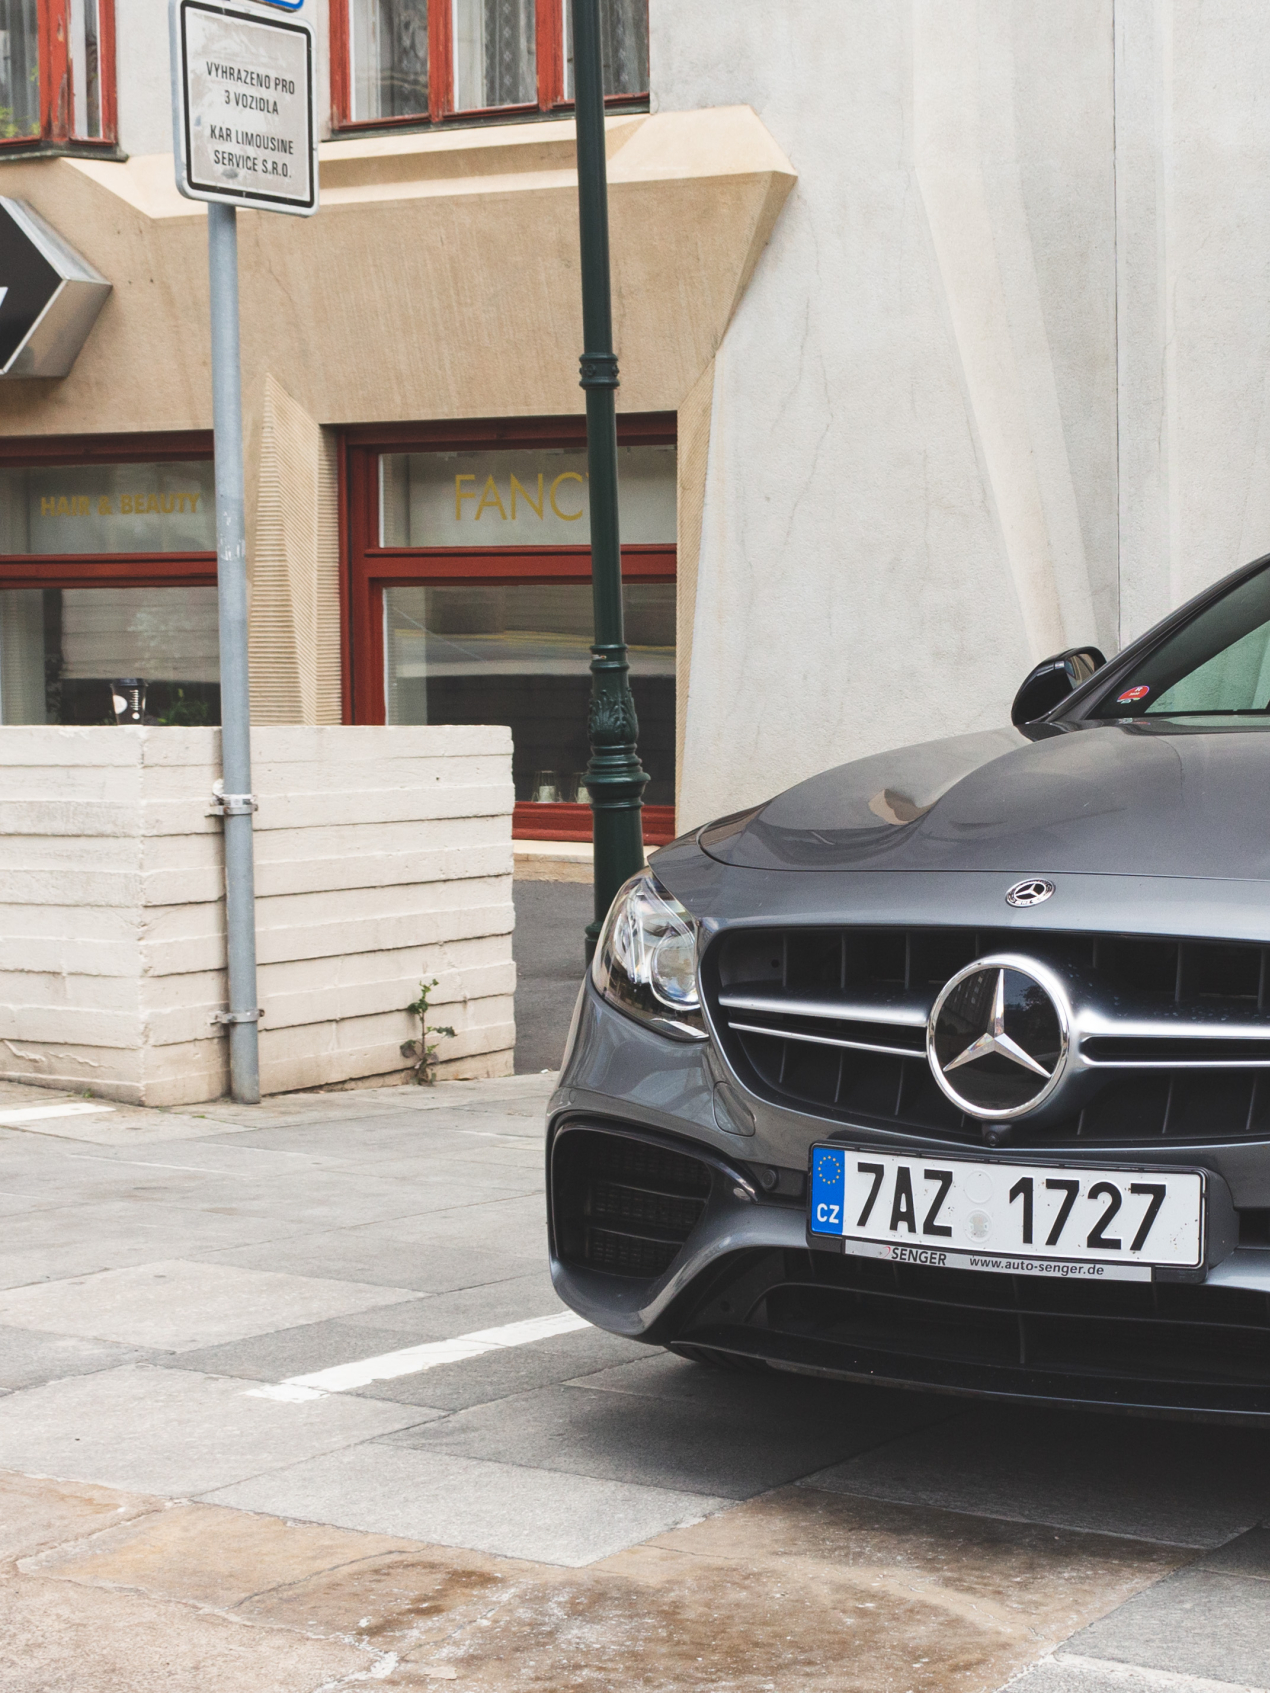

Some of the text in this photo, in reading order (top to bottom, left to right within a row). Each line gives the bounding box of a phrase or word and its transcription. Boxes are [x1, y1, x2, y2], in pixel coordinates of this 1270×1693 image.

[205, 61, 295, 95] VYHRAZENO PRO
[224, 89, 279, 115] 3 VOZIDLA
[210, 124, 294, 155] KAR LIMOUSINE
[213, 149, 292, 178] SERVICE S.R.O.
[40, 493, 200, 516] HAIR & BEAUTY
[455, 471, 588, 521] FANC
[816, 1203, 839, 1224] CZ
[857, 1161, 1167, 1251] 7AZ 1727
[891, 1247, 1104, 1277] SENGER www.auto-senger.de
